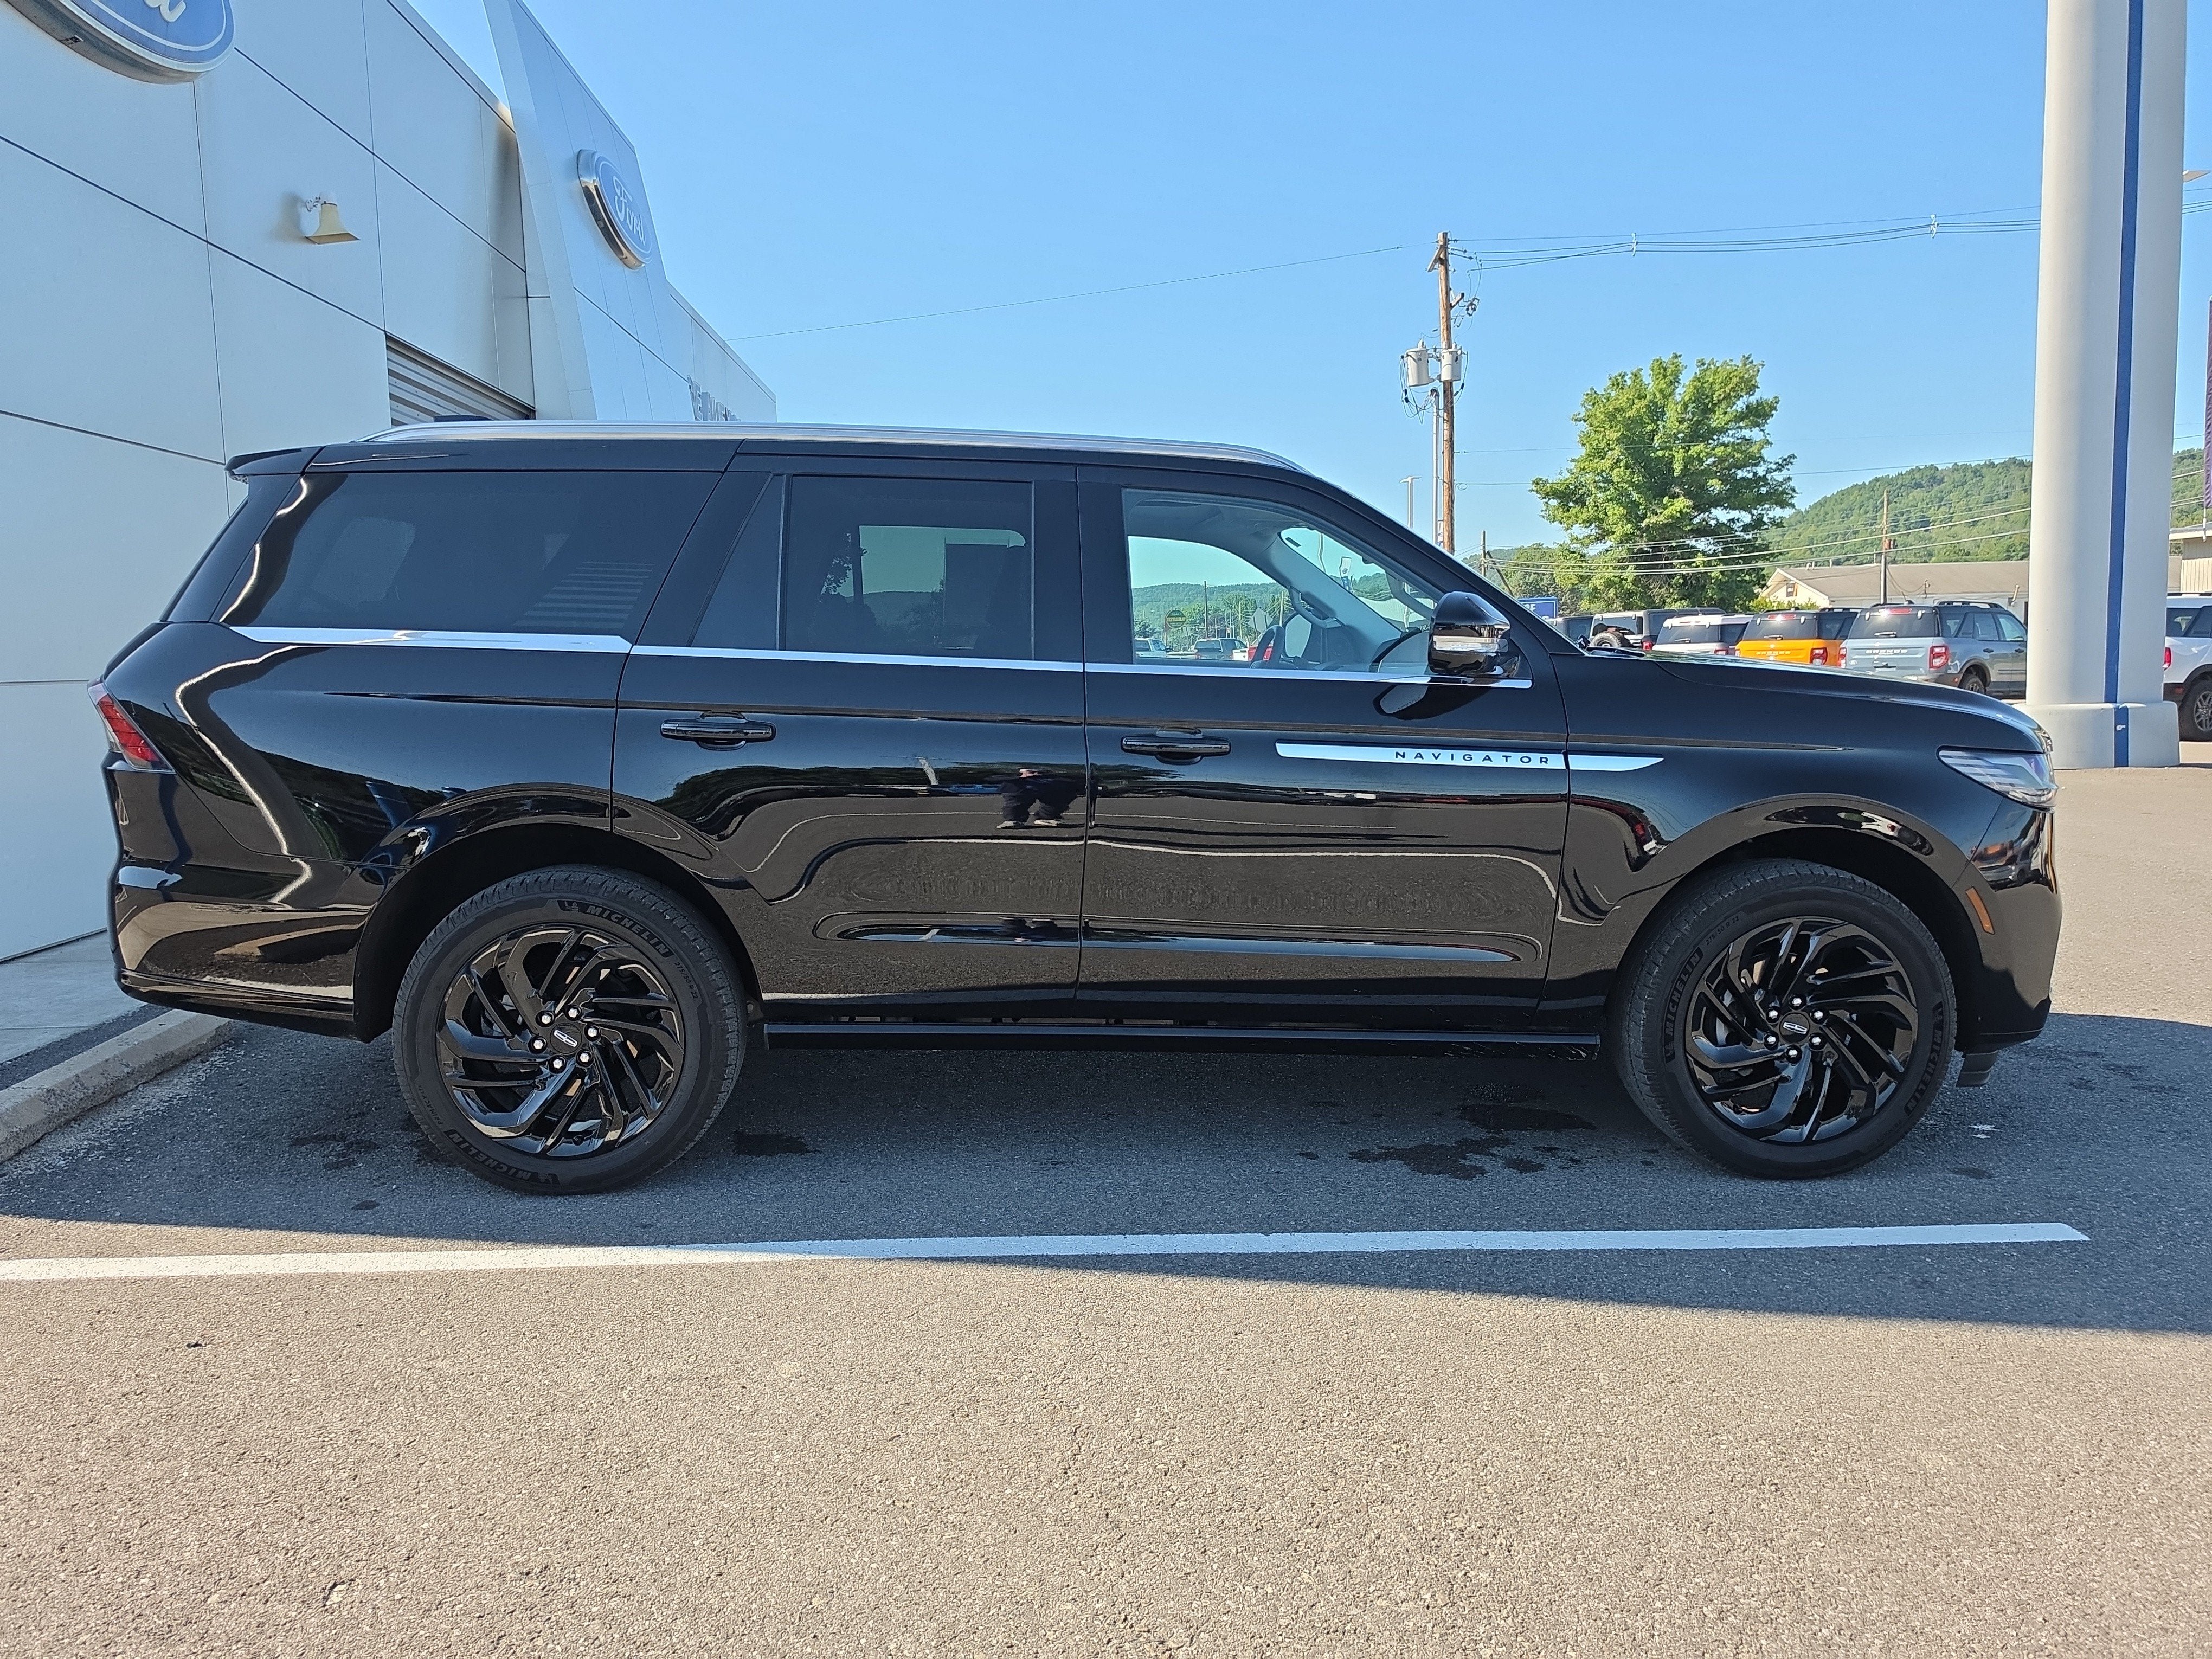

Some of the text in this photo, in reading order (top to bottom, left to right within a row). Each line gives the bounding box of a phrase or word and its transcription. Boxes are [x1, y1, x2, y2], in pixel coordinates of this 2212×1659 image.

[613, 175, 646, 246] Ford
[1395, 751, 1549, 765] NAVIGATOR
[586, 905, 670, 955] MICHELIN
[674, 962, 691, 983] 275/50
[690, 991, 698, 999] 22
[1665, 953, 1701, 1038] MICHELIN
[1907, 1030, 1943, 1110] MICHELIN
[422, 1095, 444, 1125] PRIMACY
[449, 1133, 533, 1180] MICHELIN
